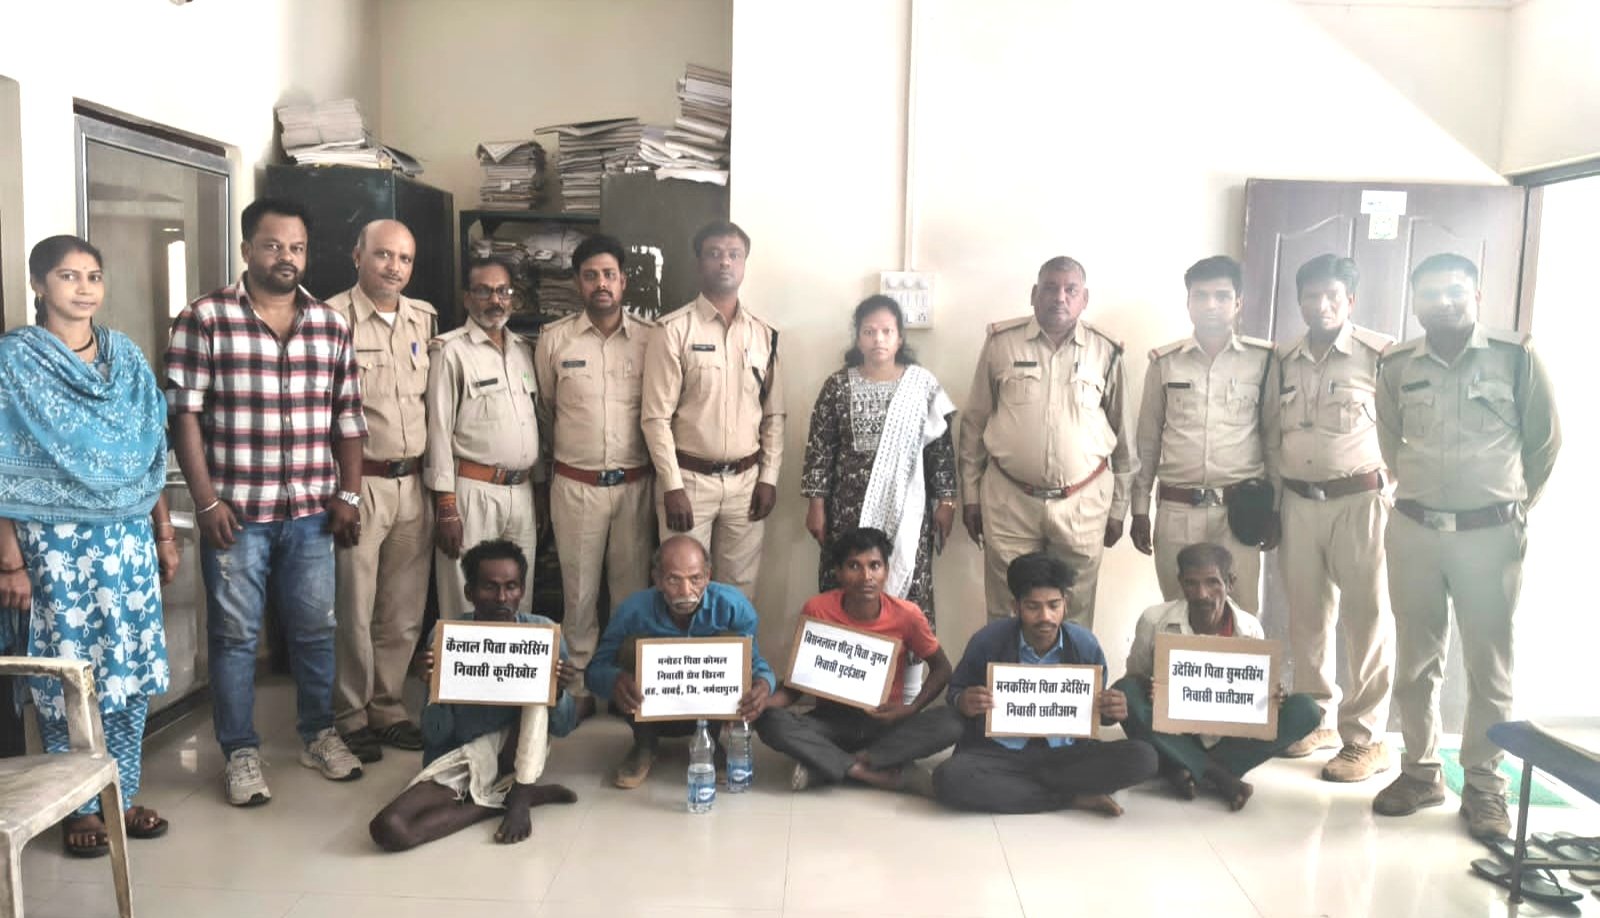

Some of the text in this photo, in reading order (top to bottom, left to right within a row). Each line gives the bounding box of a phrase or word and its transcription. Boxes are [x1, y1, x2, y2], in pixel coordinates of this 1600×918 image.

[446, 637, 549, 655] कैलाल पिता कारेसिंग
[854, 644, 869, 660] पिता
[684, 655, 701, 665] पिता
[703, 655, 728, 665] कोमल
[814, 655, 838, 673] निवासी
[454, 661, 538, 682] निवासी कूचीखोह
[657, 670, 684, 680] निवासी
[1172, 661, 1264, 684] उदेसिंग पिता सुमरसिंग
[996, 678, 1090, 695] मनकसिंग पिता उदेसिंग
[1182, 686, 1254, 705] निवासी छातीआम
[1006, 702, 1078, 718] निवासी छातीआम
